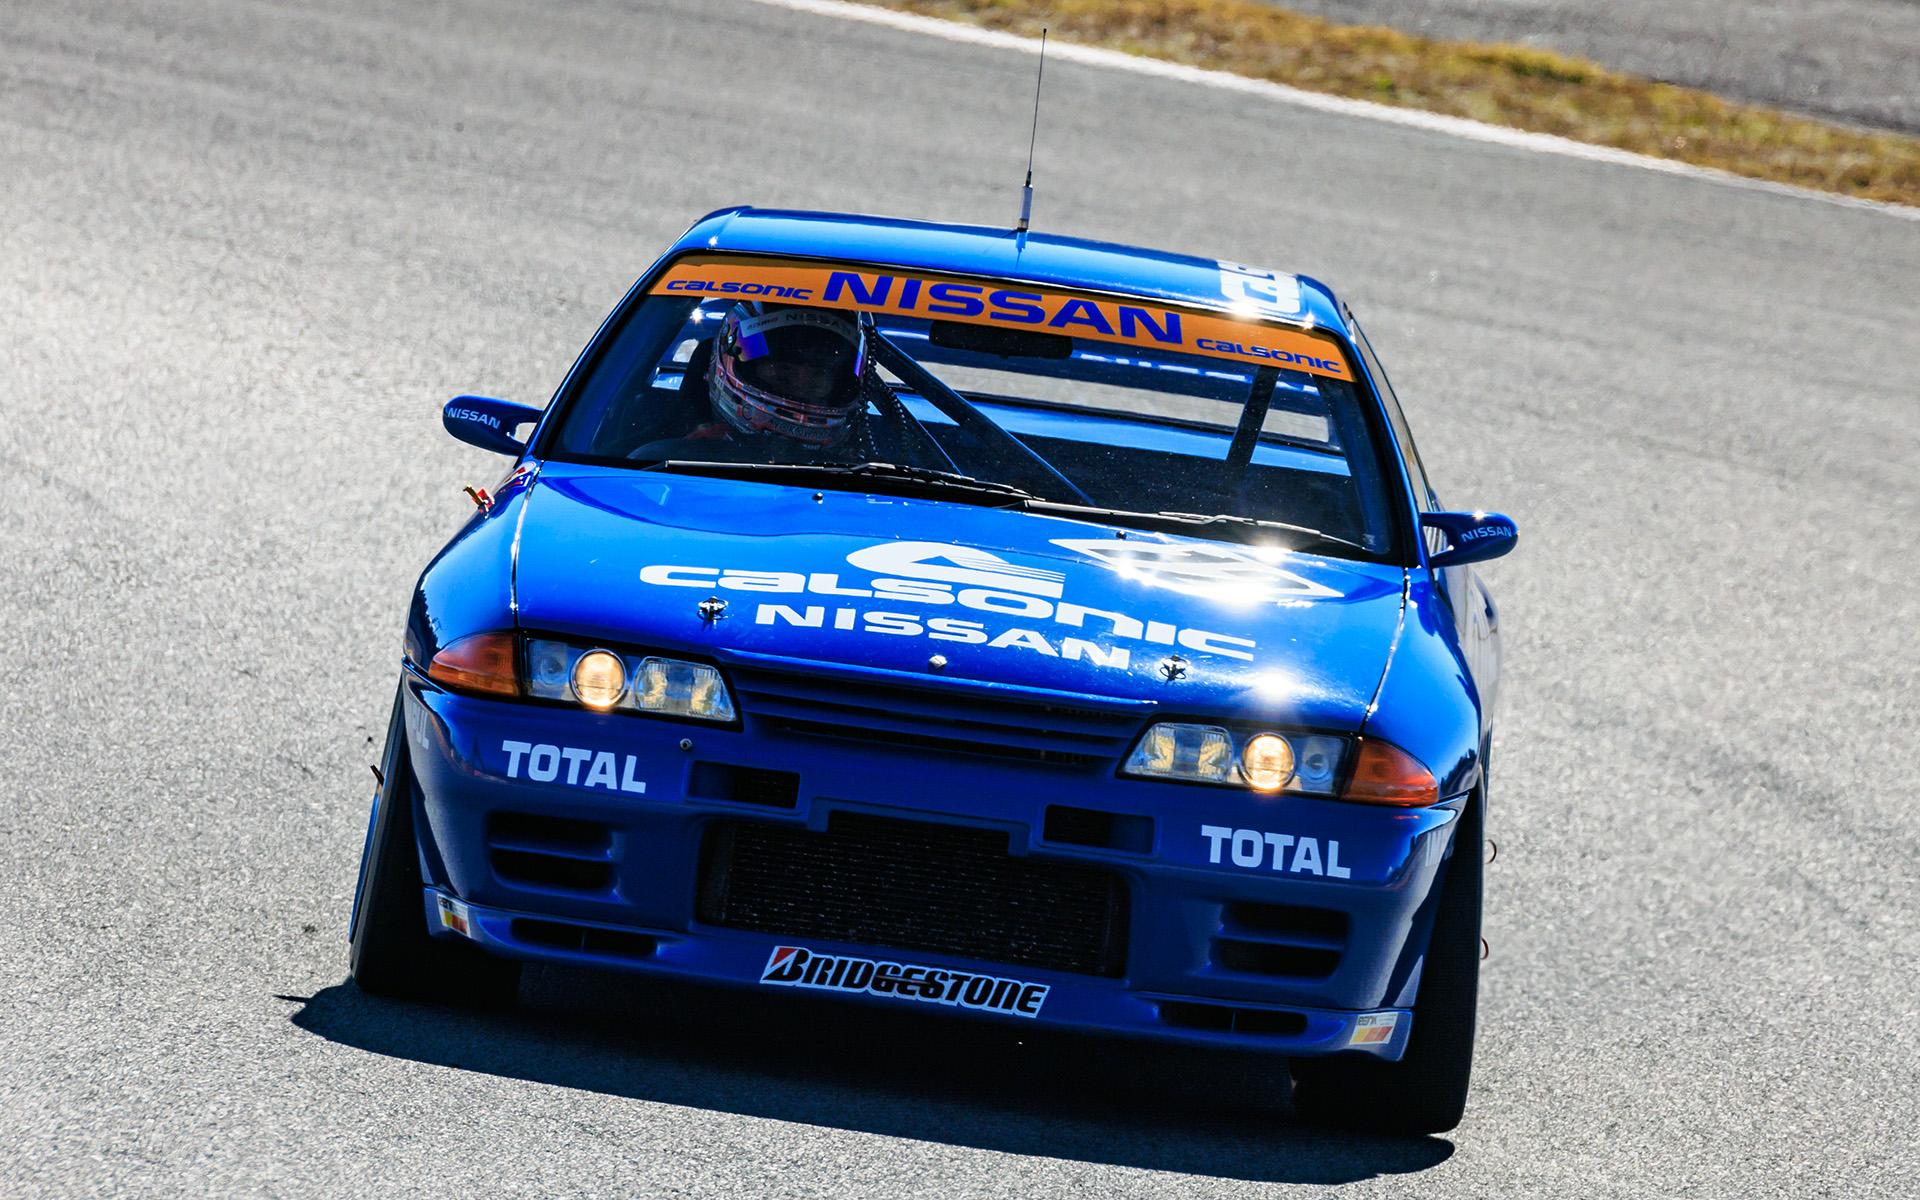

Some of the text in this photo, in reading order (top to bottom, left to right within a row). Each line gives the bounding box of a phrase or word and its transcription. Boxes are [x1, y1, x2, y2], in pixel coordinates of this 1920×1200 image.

[785, 313, 851, 335] NISSAN
[823, 271, 1183, 345] NISSAN
[447, 407, 501, 430] NISSAN
[1461, 526, 1513, 543] NISSAN
[756, 603, 1130, 670] NISSAN
[502, 739, 646, 794] TOTAL
[1201, 824, 1351, 879] TOTAL
[761, 946, 1049, 1018] BRIDGESTONE
